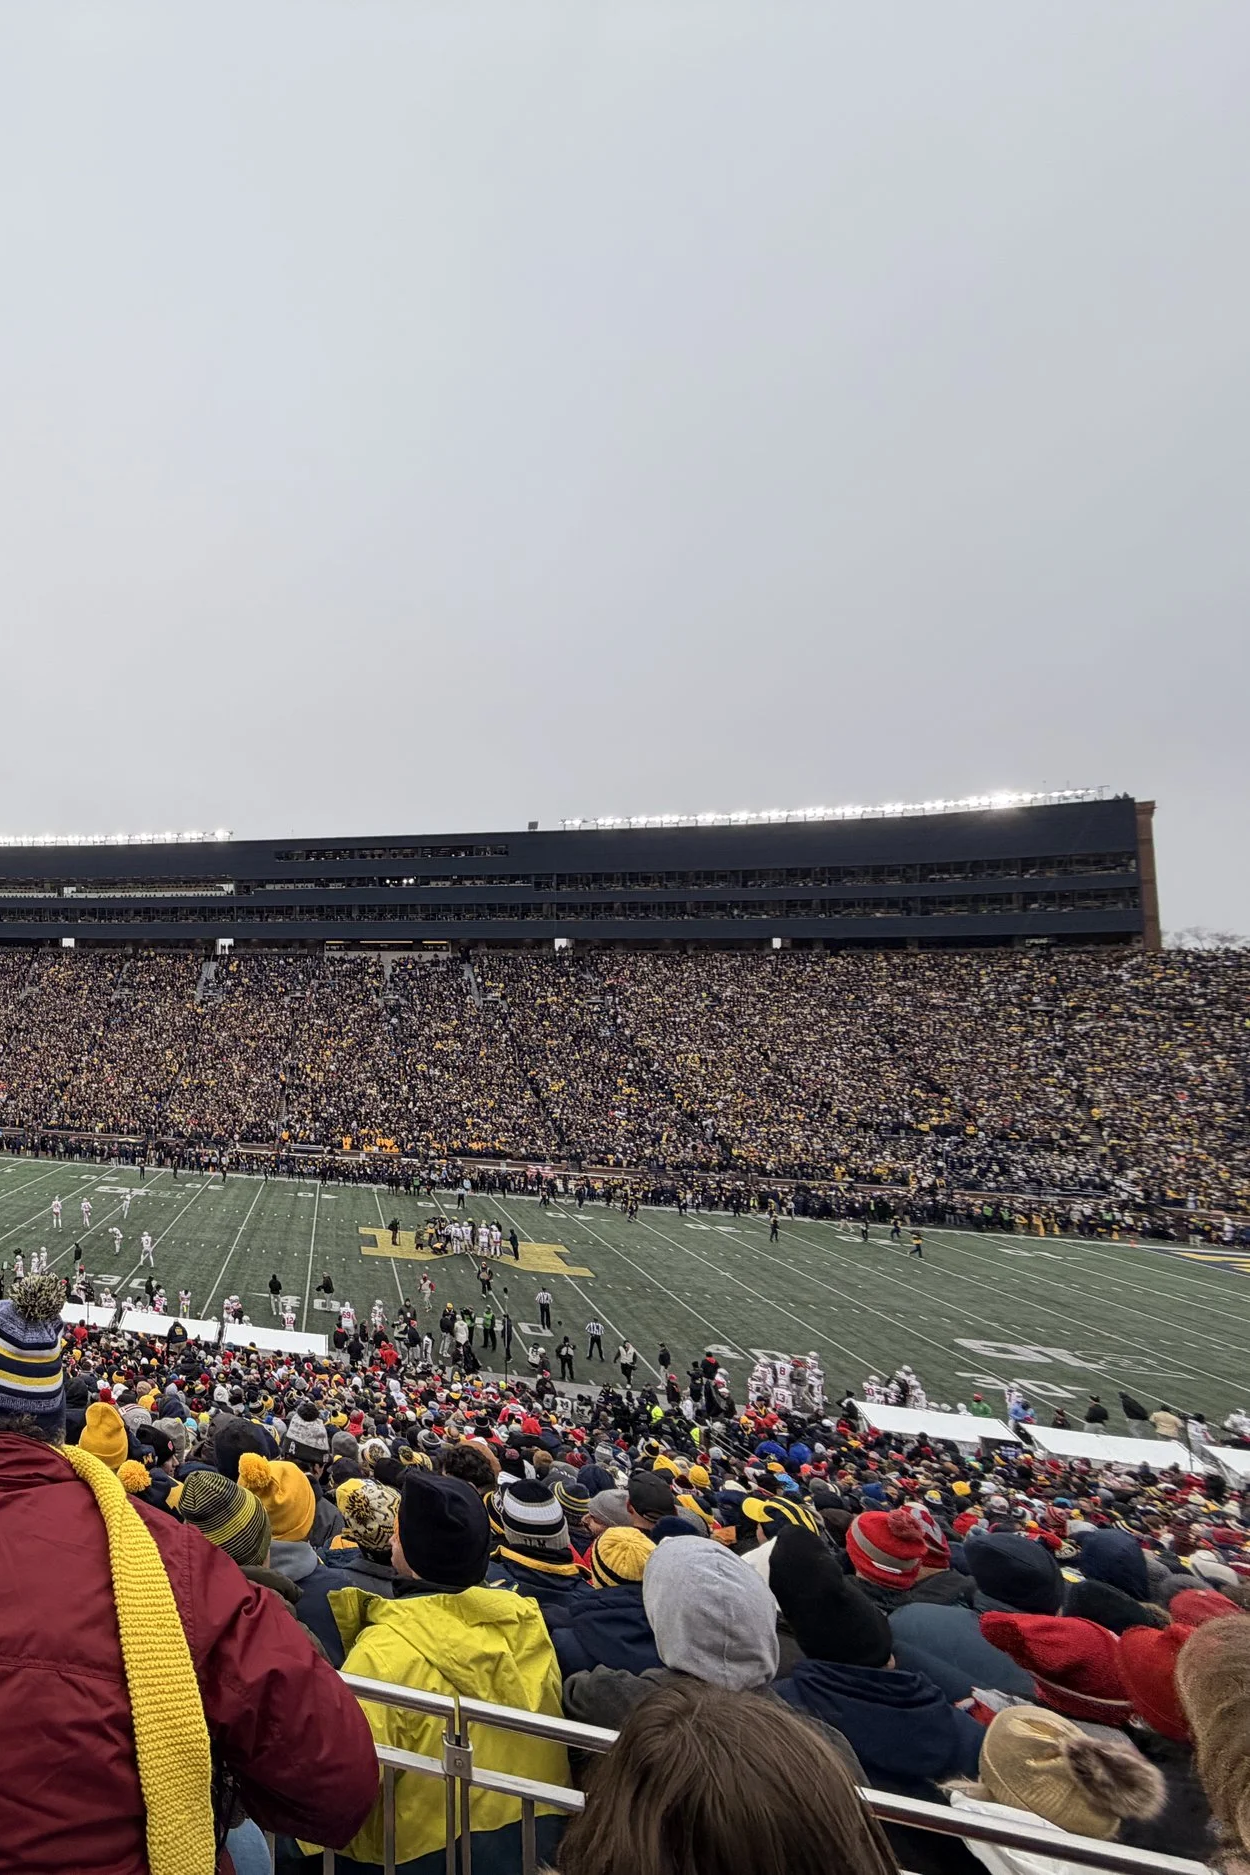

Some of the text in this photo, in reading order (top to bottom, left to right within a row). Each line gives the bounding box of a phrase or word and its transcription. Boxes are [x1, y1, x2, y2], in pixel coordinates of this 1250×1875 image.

[286, 1316, 294, 1326] 12
[779, 1366, 786, 1376] 8
[954, 1372, 1077, 1399] 30
